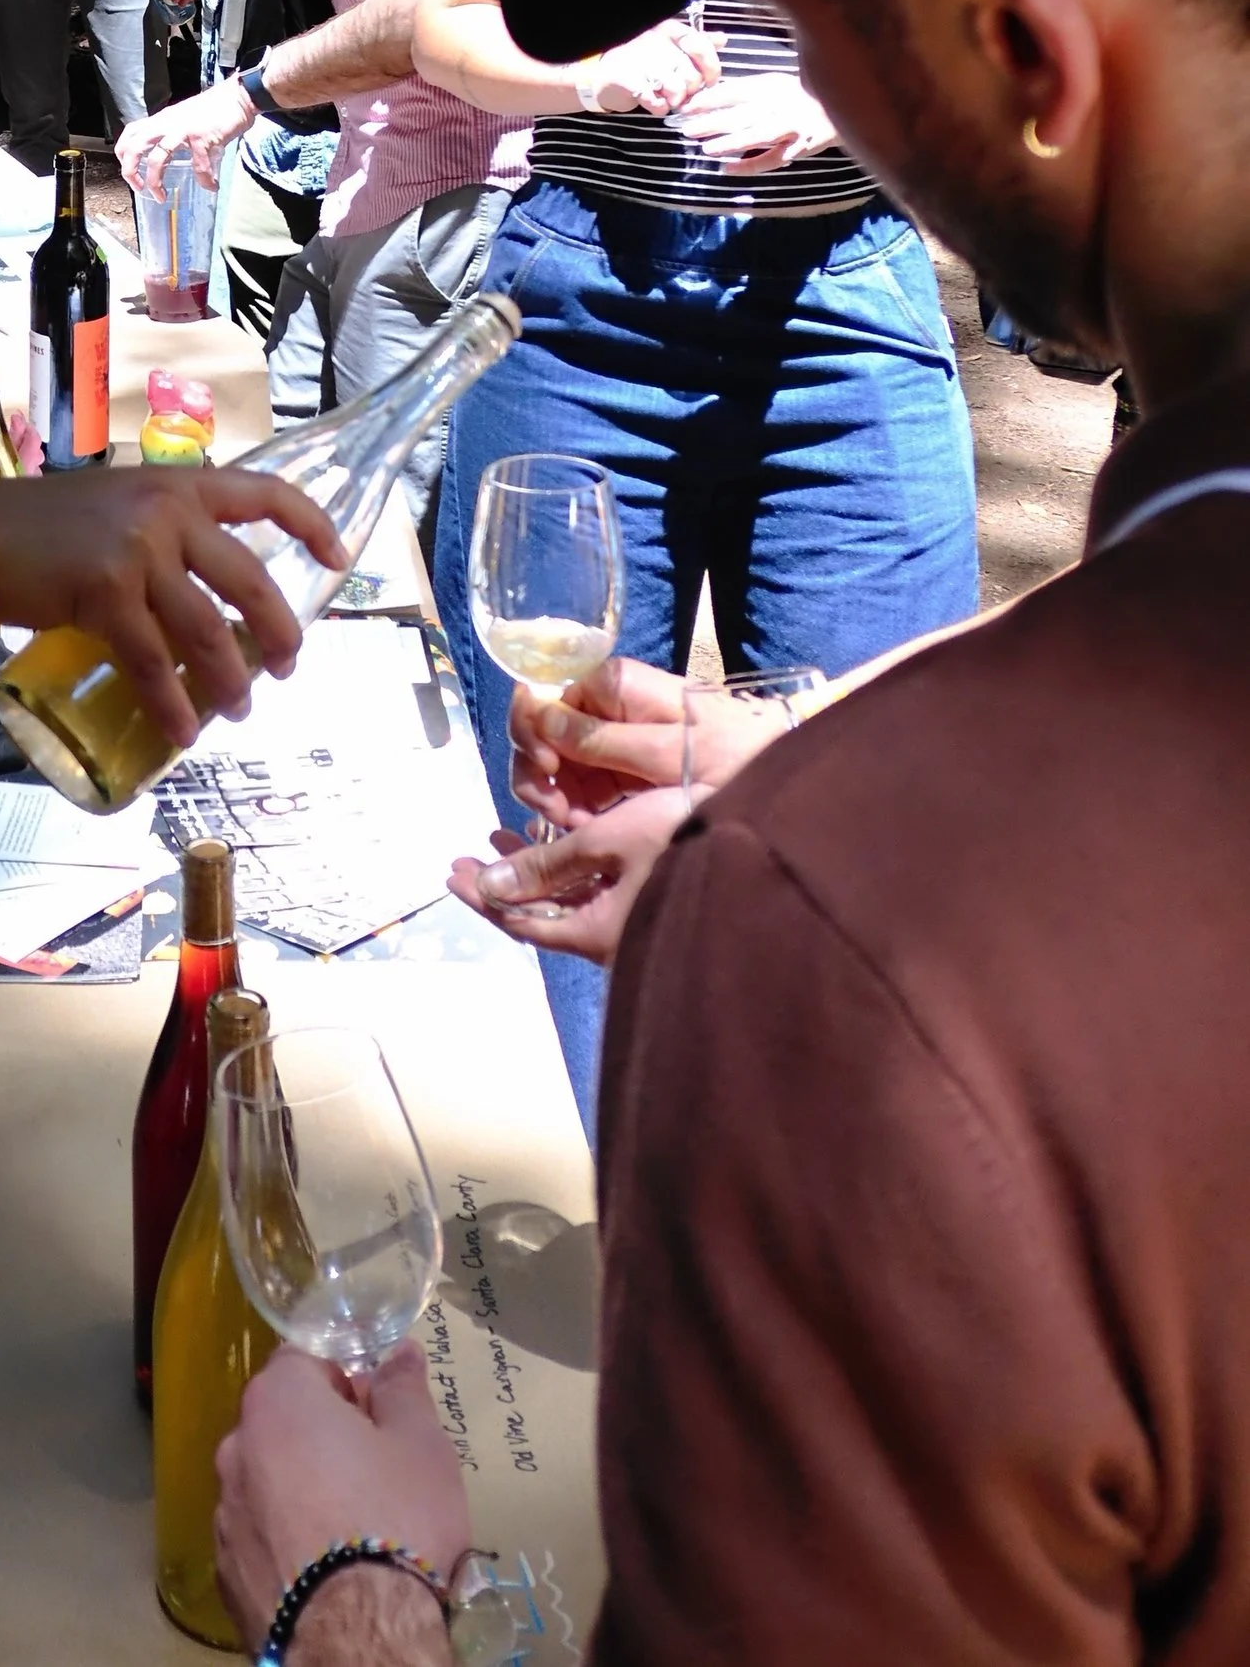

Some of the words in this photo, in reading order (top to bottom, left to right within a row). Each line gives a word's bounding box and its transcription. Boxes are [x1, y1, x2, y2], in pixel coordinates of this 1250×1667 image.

[451, 1173, 487, 1222] County
[461, 1227, 484, 1269] Clara
[472, 1274, 499, 1319] Santa
[431, 1372, 467, 1435] Contact
[506, 1410, 529, 1445] Vine
[514, 1449, 538, 1473] Old
